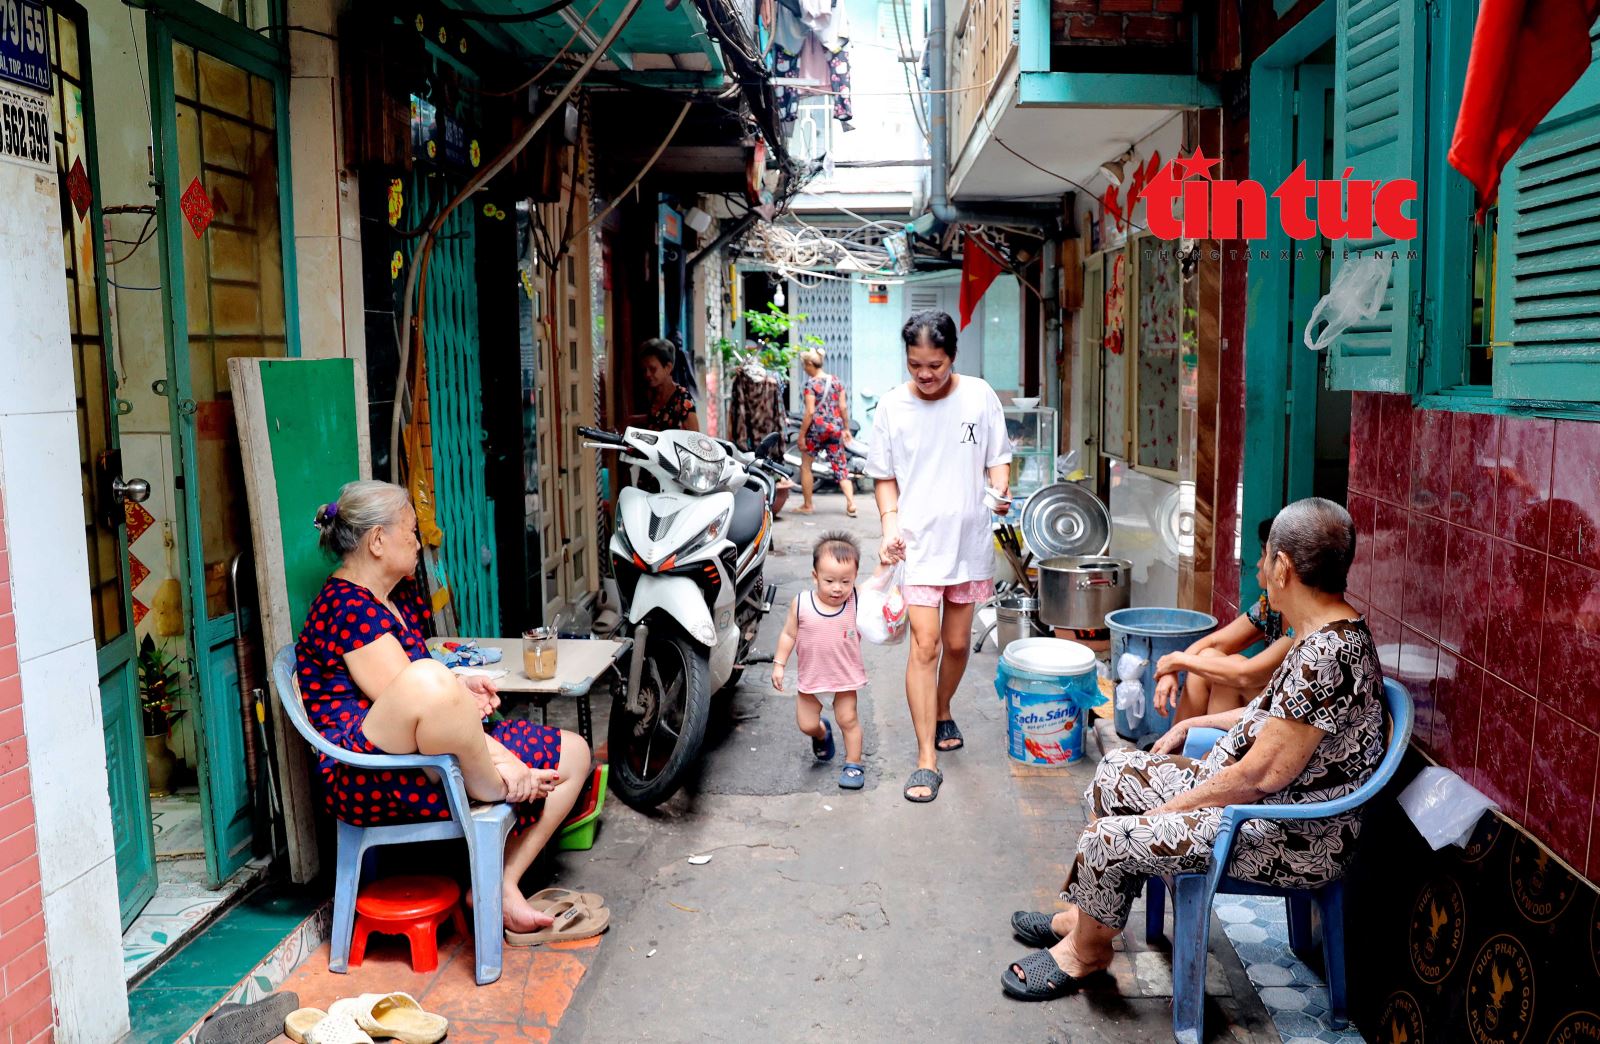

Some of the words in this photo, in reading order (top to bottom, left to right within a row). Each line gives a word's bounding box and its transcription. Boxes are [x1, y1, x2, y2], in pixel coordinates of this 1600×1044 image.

[1046, 706, 1076, 720] Sáng
[1494, 943, 1518, 958] PHAT
[1476, 949, 1493, 975] DUC
[1516, 956, 1529, 981] SAI
[1519, 986, 1530, 1022] GON
[1556, 1026, 1571, 1044] UC
